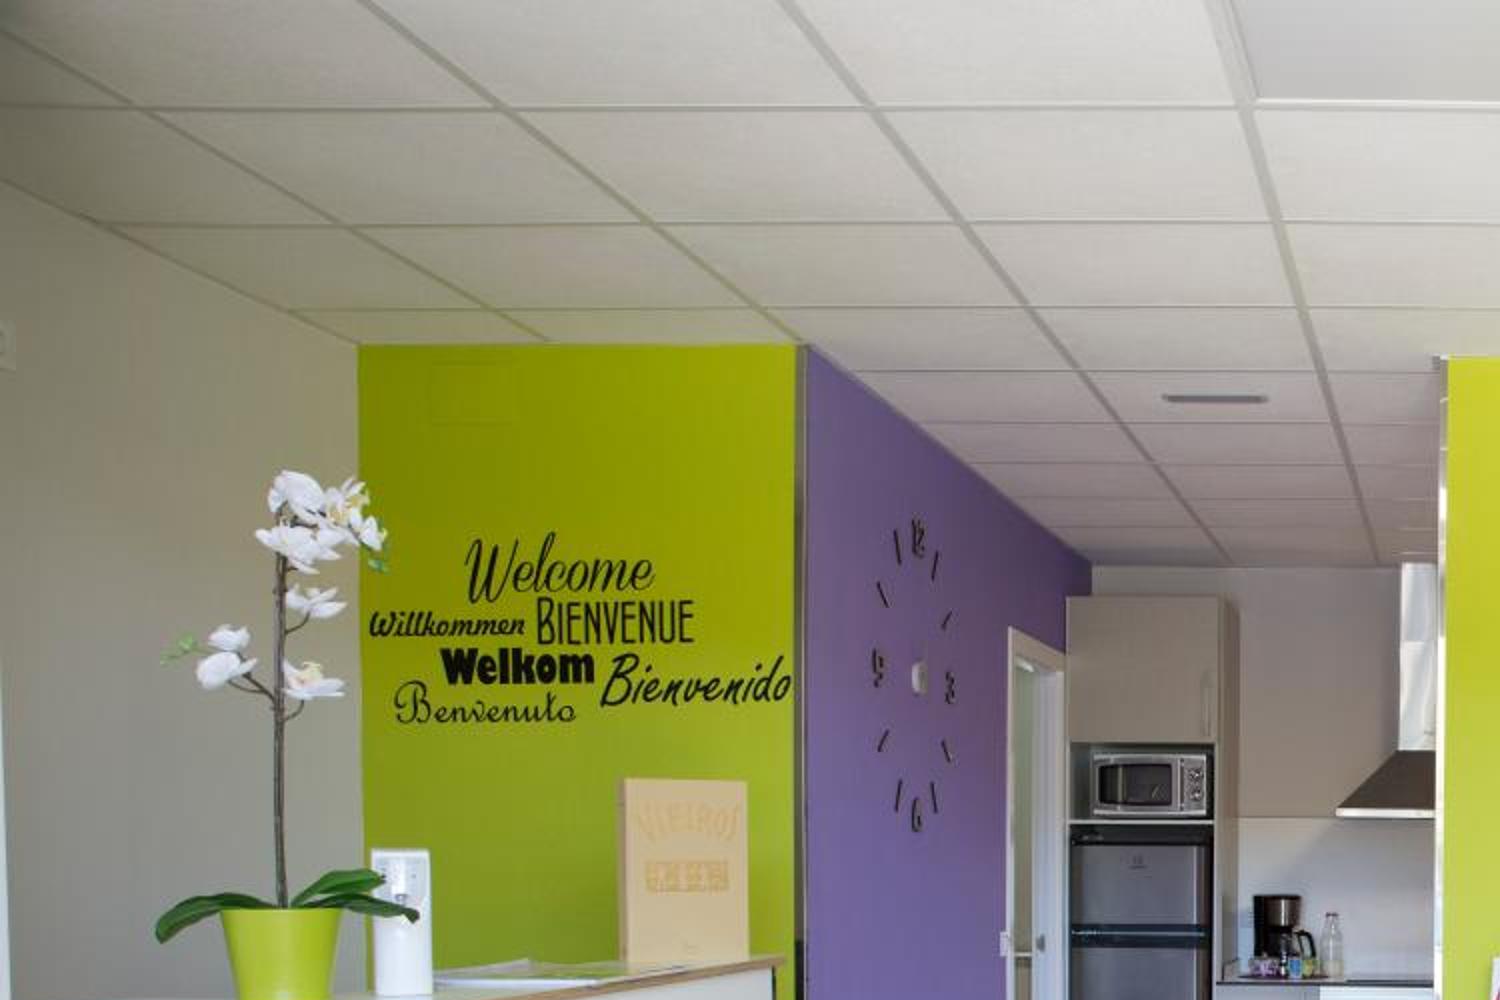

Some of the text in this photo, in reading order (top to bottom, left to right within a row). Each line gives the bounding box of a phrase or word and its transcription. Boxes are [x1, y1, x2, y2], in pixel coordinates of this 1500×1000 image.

[465, 531, 653, 605] Welcome
[369, 610, 526, 638] Willkommen
[537, 599, 695, 646] BIENVENUE
[440, 647, 595, 686] Welkom
[600, 652, 792, 708] Bienvenido
[394, 679, 577, 725] Benvenuto
